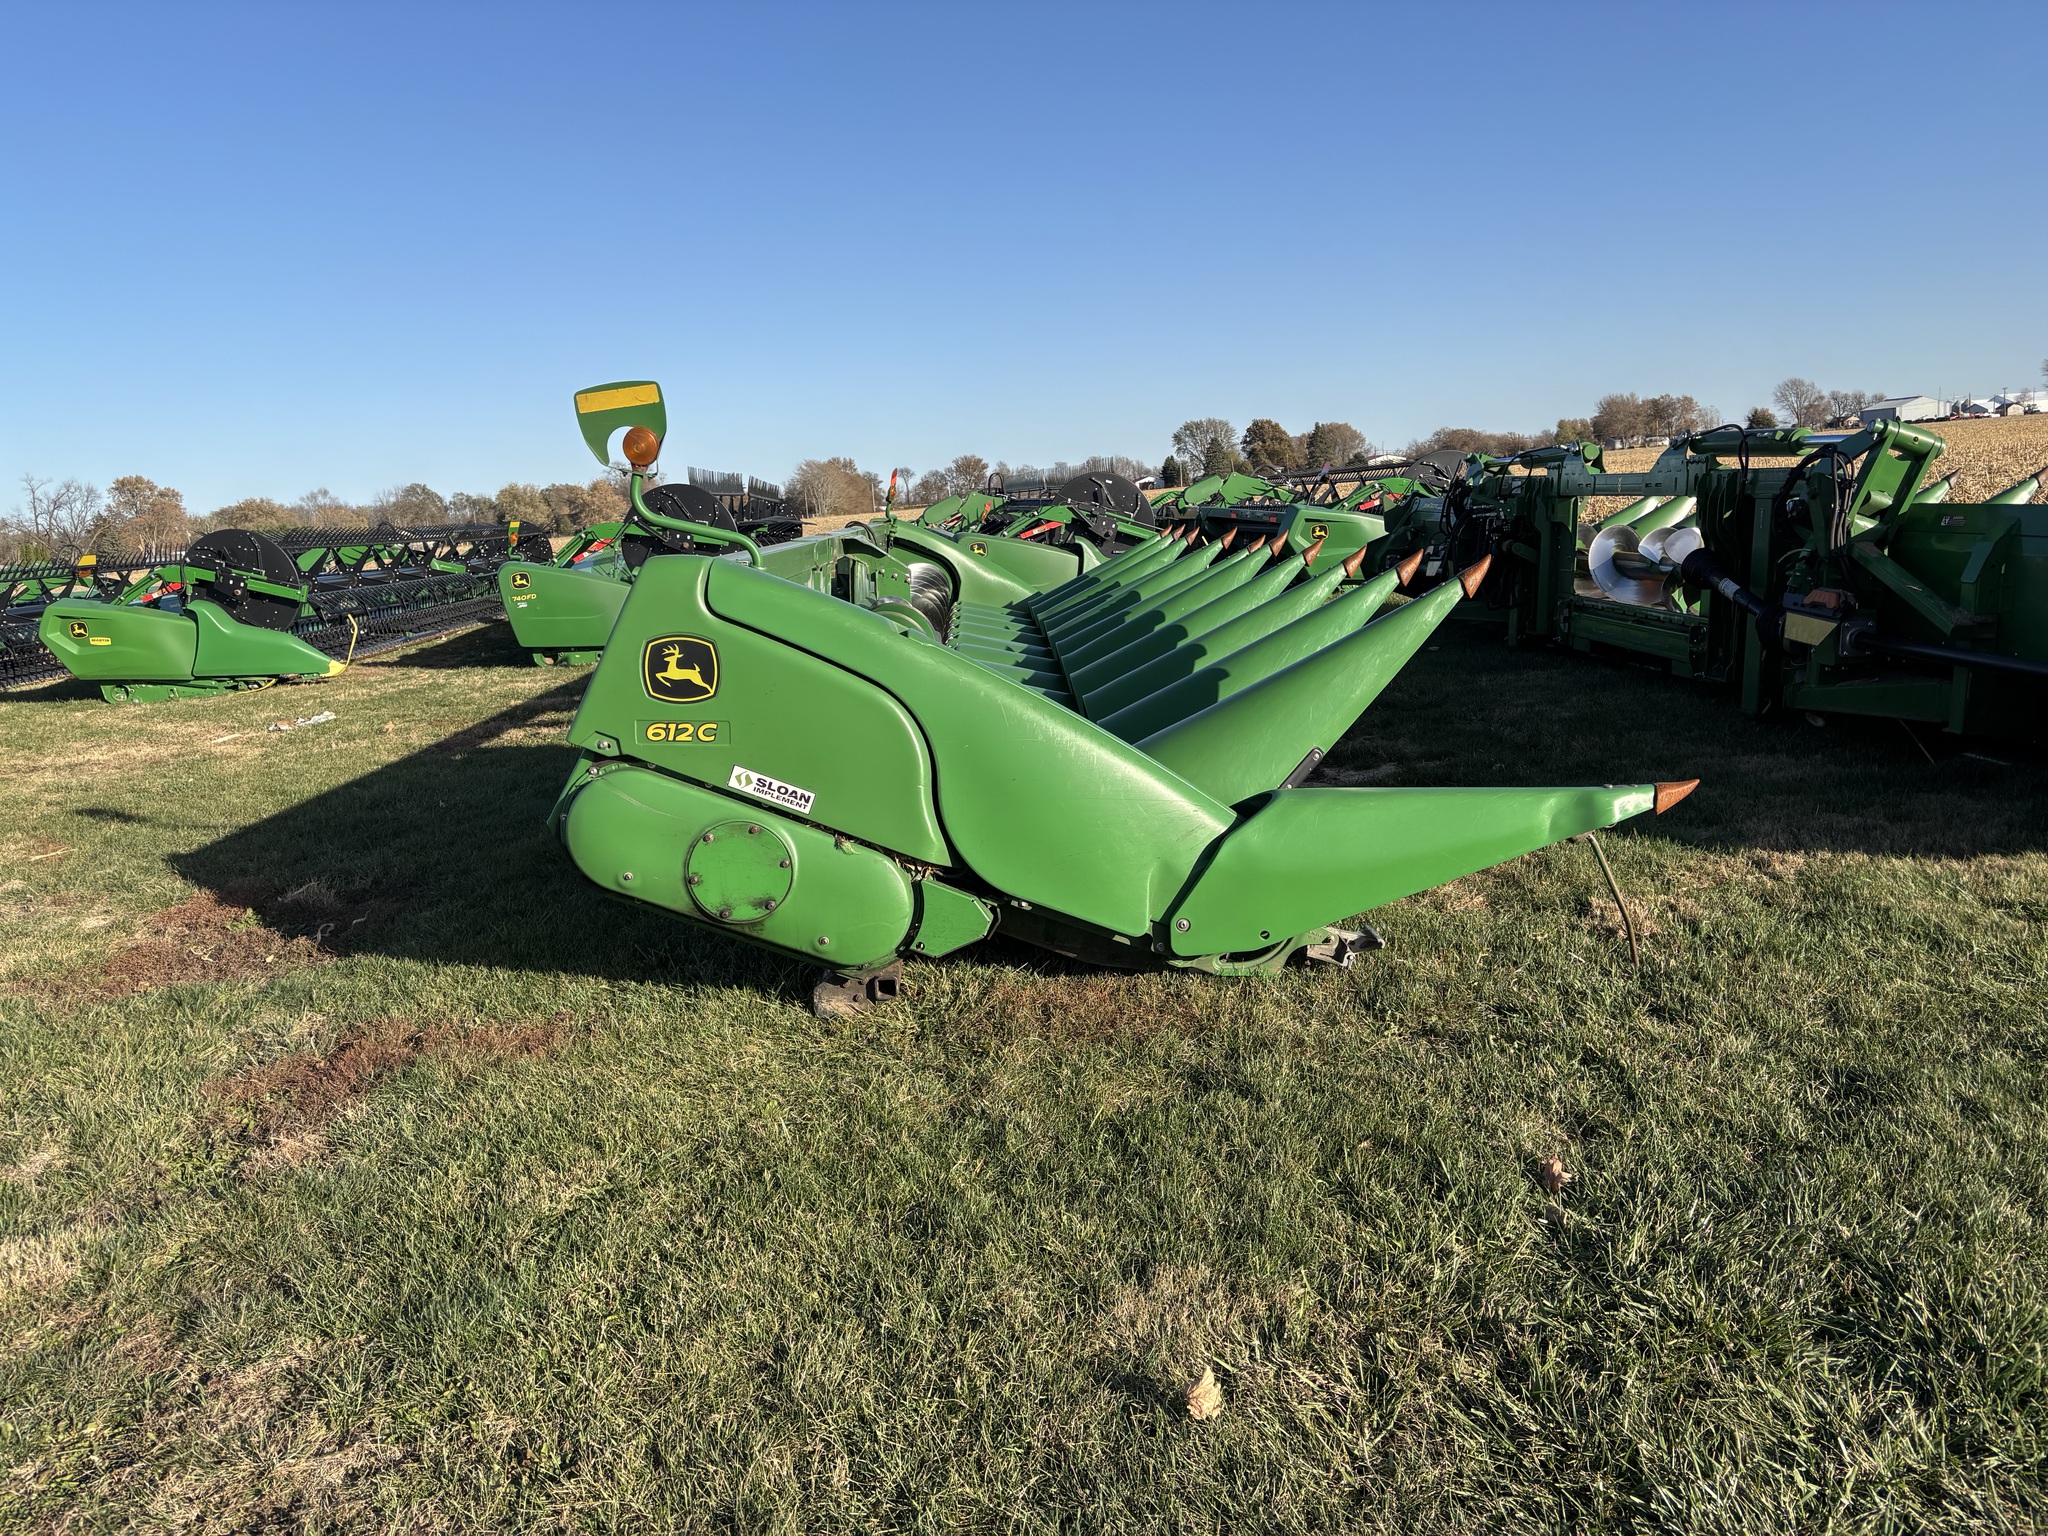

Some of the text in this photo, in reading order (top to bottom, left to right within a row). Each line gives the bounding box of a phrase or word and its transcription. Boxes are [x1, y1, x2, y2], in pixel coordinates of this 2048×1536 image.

[512, 593, 537, 602] 740FD
[646, 722, 718, 742] 612C
[753, 786, 809, 810] IMPLEMENT
[755, 777, 811, 803] SLOAN
